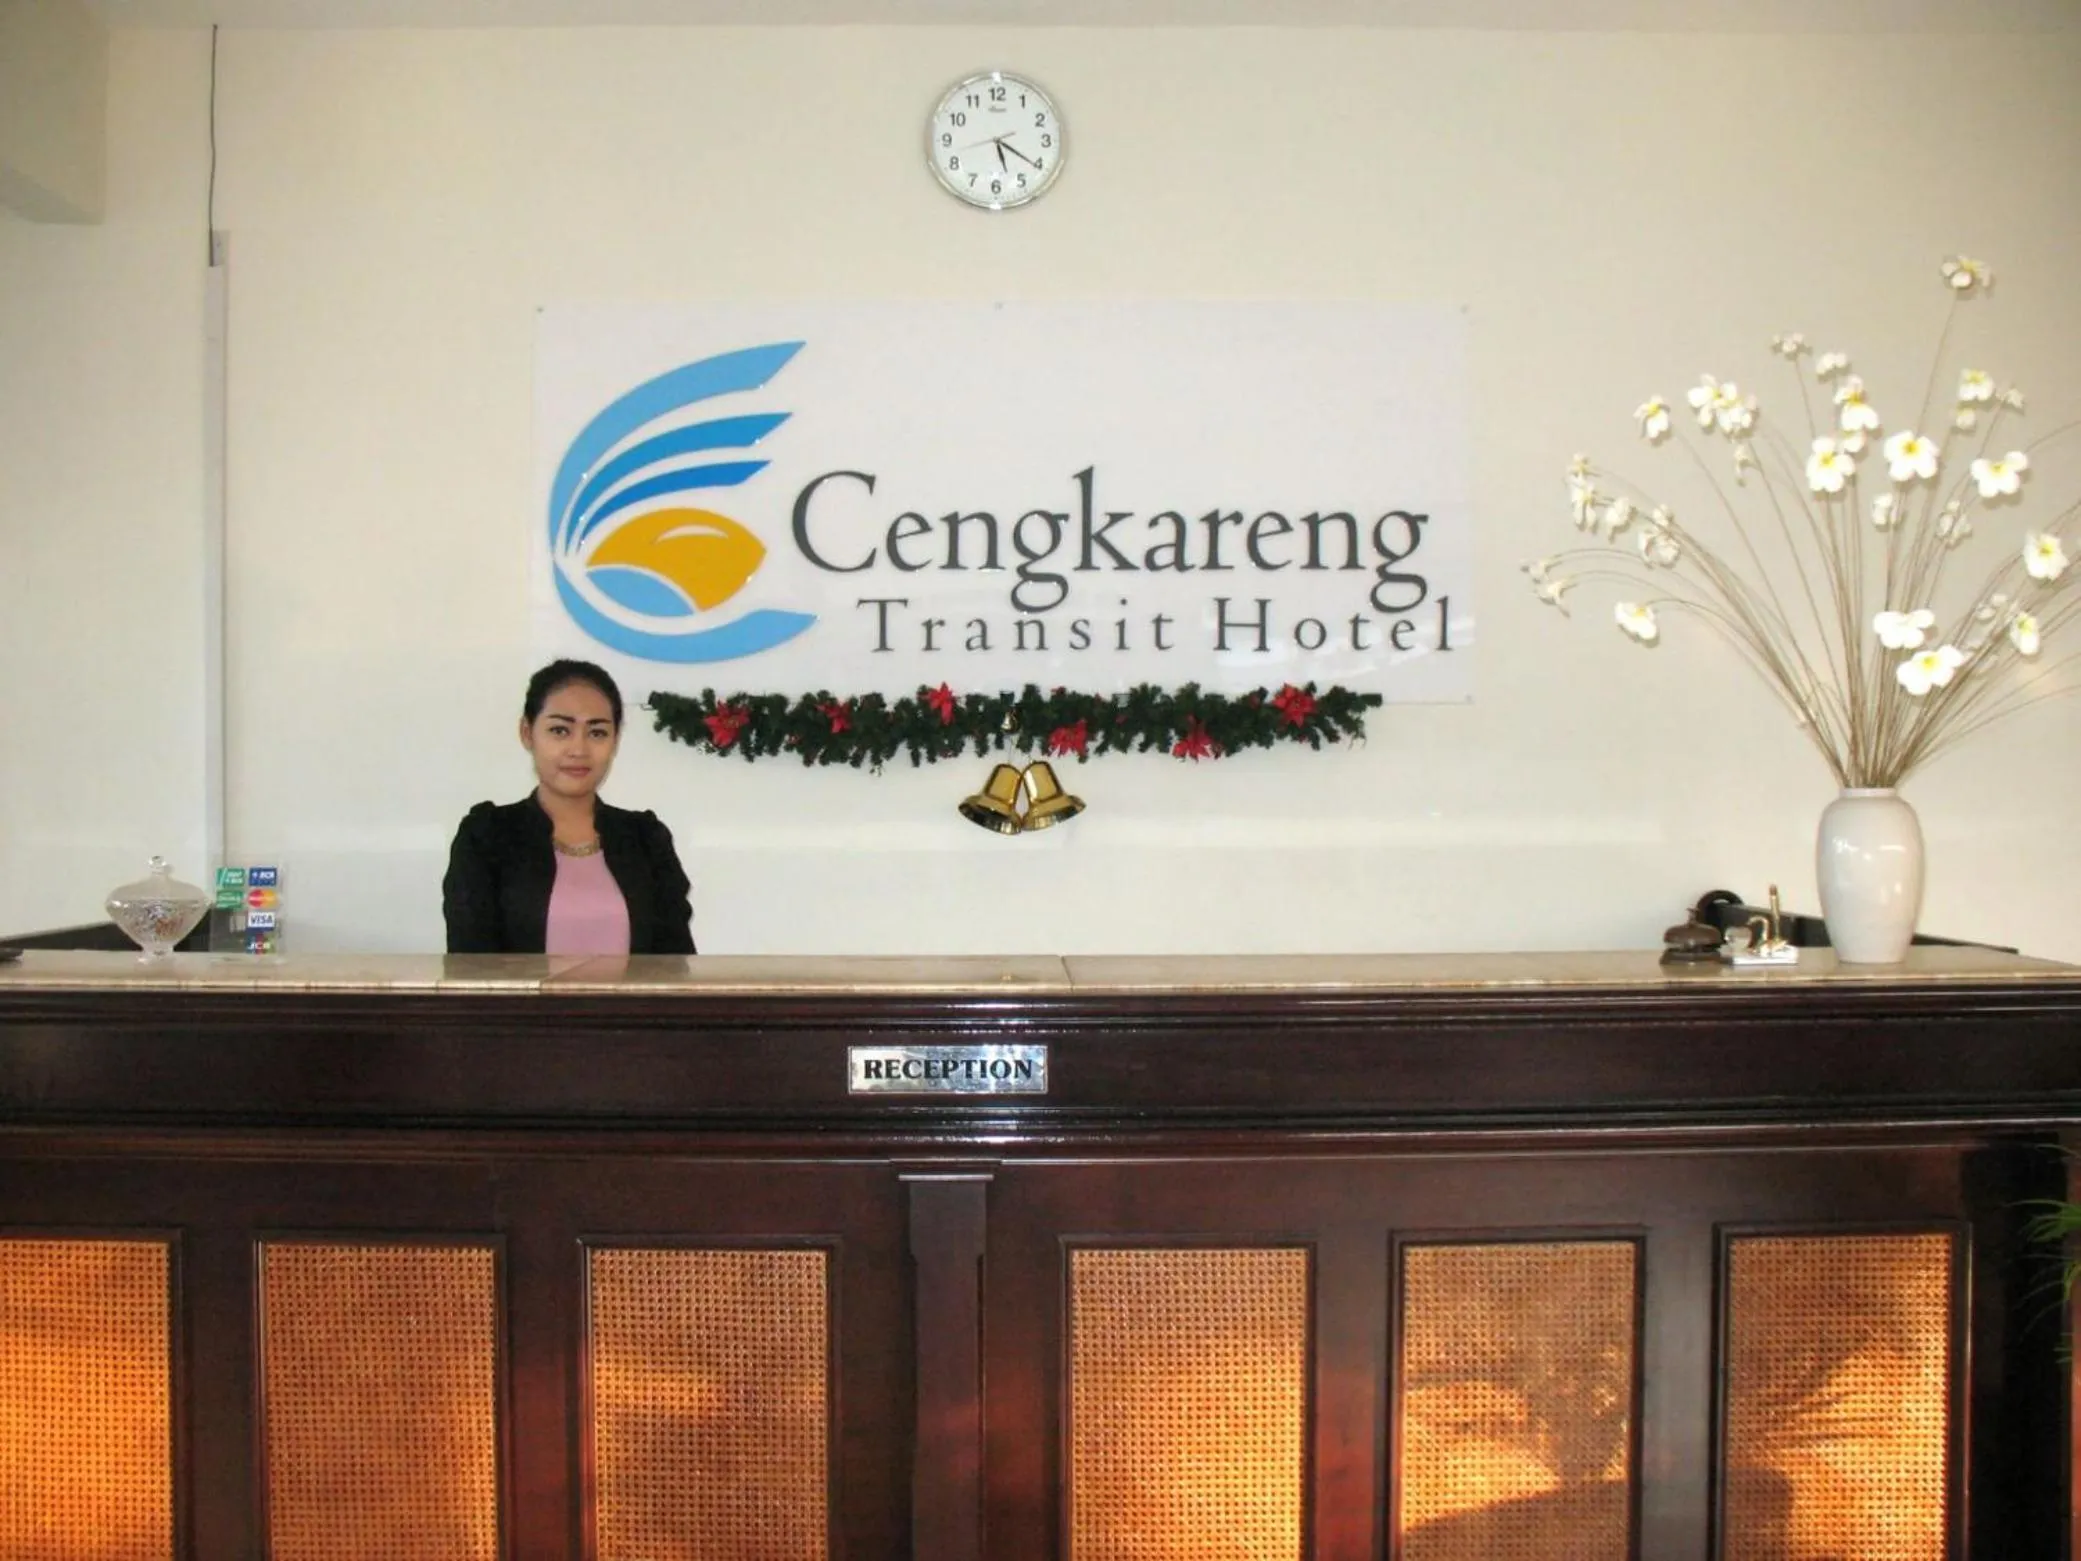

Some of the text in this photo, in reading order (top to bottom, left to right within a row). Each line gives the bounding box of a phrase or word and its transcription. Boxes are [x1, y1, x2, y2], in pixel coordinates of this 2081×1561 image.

[988, 86, 1006, 101] 12
[965, 94, 979, 108] 11
[1019, 94, 1026, 109] 1
[950, 112, 966, 127] 10
[1035, 113, 1045, 127] 2
[942, 133, 952, 147] 9
[1041, 133, 1052, 148] 3
[949, 156, 959, 170] 8
[1033, 157, 1043, 170] 4
[968, 173, 978, 187] 7
[991, 180, 1001, 194] 6
[1017, 173, 1026, 188] 5
[791, 465, 1429, 614] Cengkareng
[857, 596, 1454, 652] Transit Hotel
[251, 914, 273, 924] VISA
[864, 1059, 1032, 1079] RECEPTION
